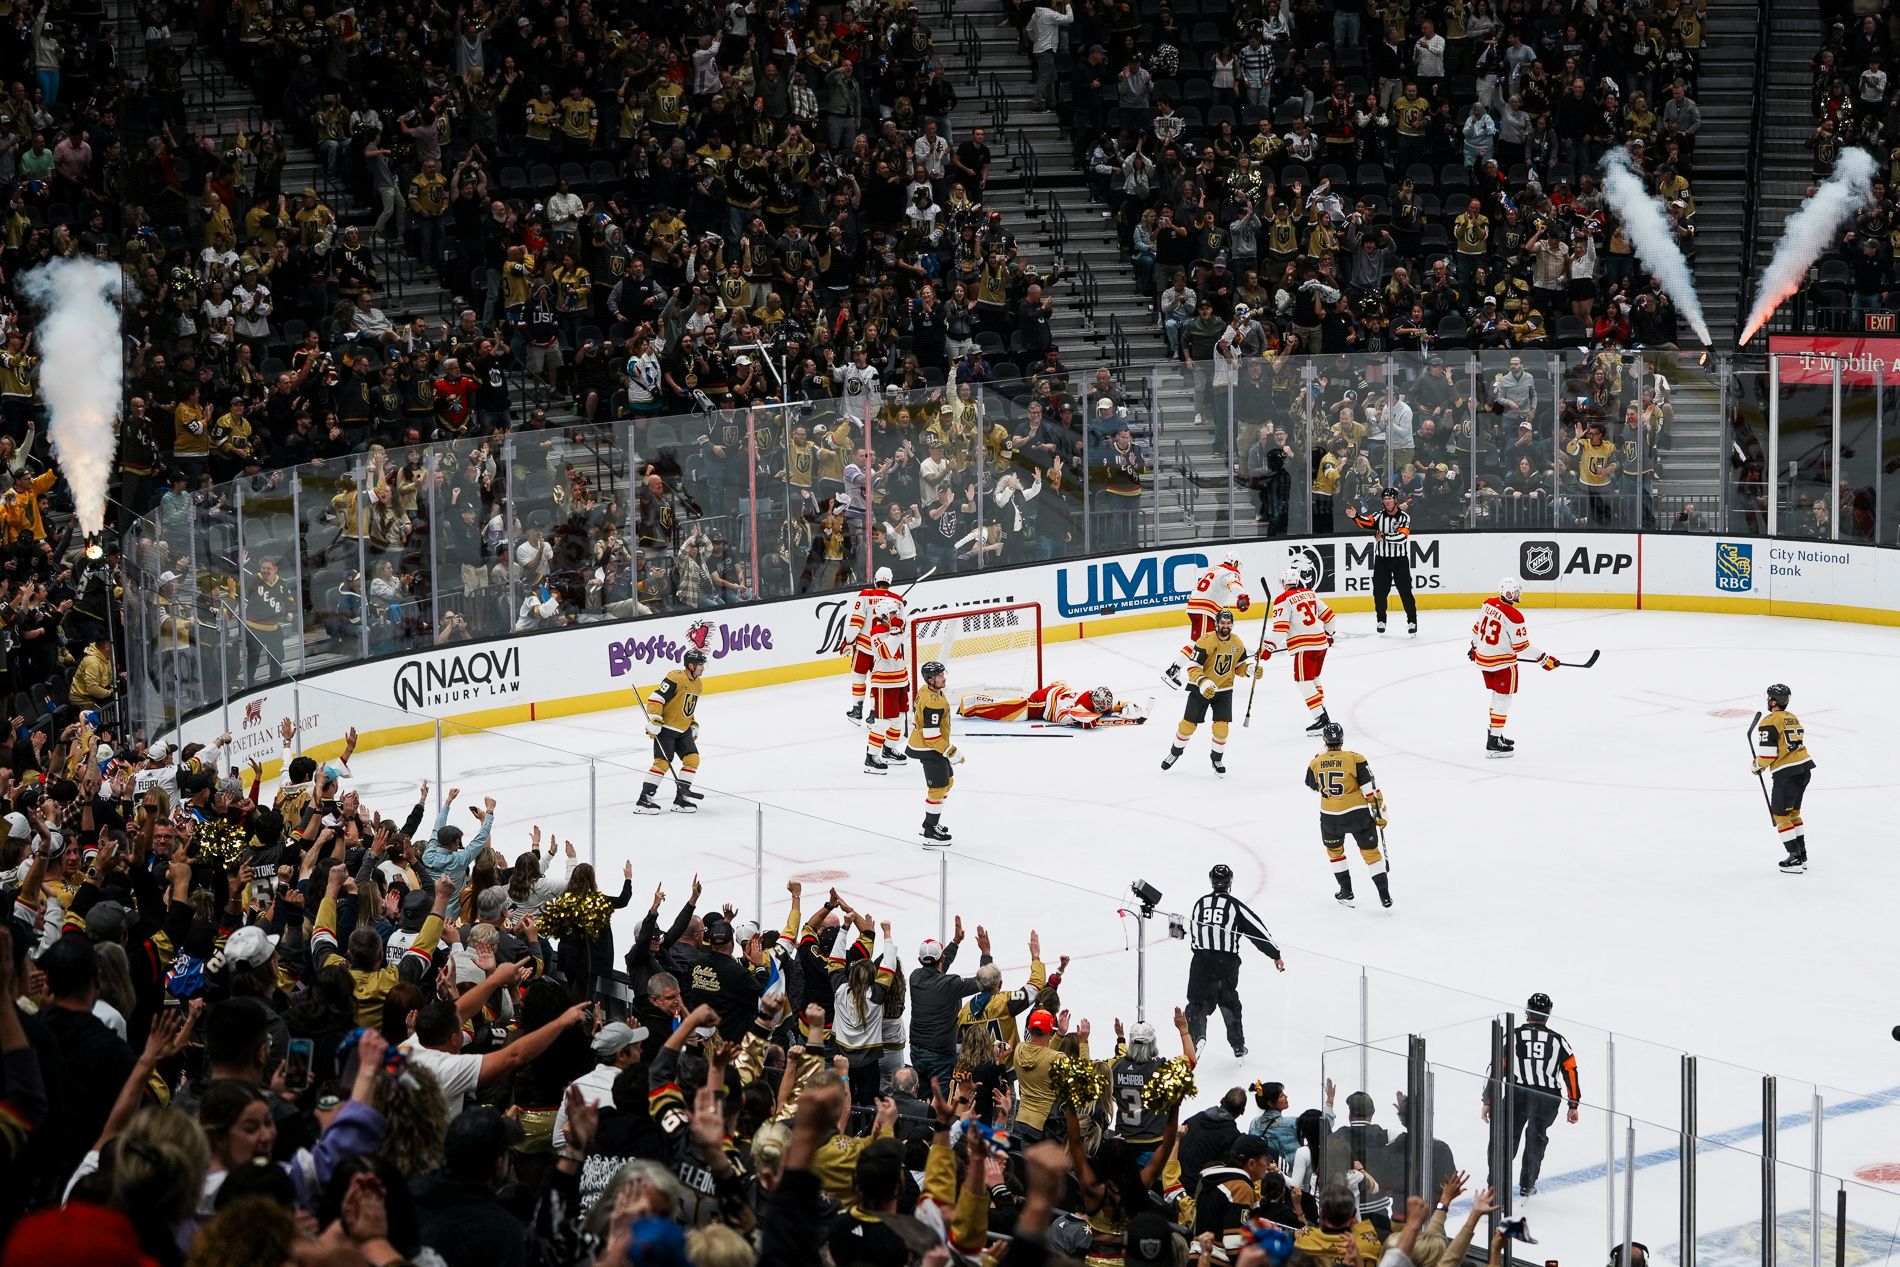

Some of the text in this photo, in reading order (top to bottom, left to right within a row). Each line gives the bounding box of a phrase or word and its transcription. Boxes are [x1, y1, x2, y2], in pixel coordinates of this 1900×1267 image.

[1871, 315, 1891, 330] EXIT
[1345, 540, 1440, 571] MM
[1769, 548, 1850, 565] City National
[1770, 565, 1802, 577] Bank
[1057, 553, 1209, 618] UMC
[1719, 577, 1749, 590] RBC
[1121, 596, 1161, 608] MEDICAL
[1163, 594, 1192, 603] CENTE
[1272, 608, 1284, 617] 37
[1297, 601, 1318, 627] 37
[1480, 615, 1502, 646] 43
[1515, 626, 1527, 637] 43
[608, 634, 686, 677] Booster
[713, 623, 773, 659] Juice
[426, 647, 520, 692] NAQVI
[428, 681, 520, 706] INJURY LAW
[930, 713, 940, 725] 9
[1320, 760, 1342, 768] HANIFIN
[138, 779, 159, 790] FLEURY
[1318, 771, 1345, 798] 15
[1203, 908, 1224, 924] 96
[1525, 1041, 1545, 1059] 19
[1117, 1073, 1144, 1086] McNABB
[1120, 1088, 1143, 1126] 3
